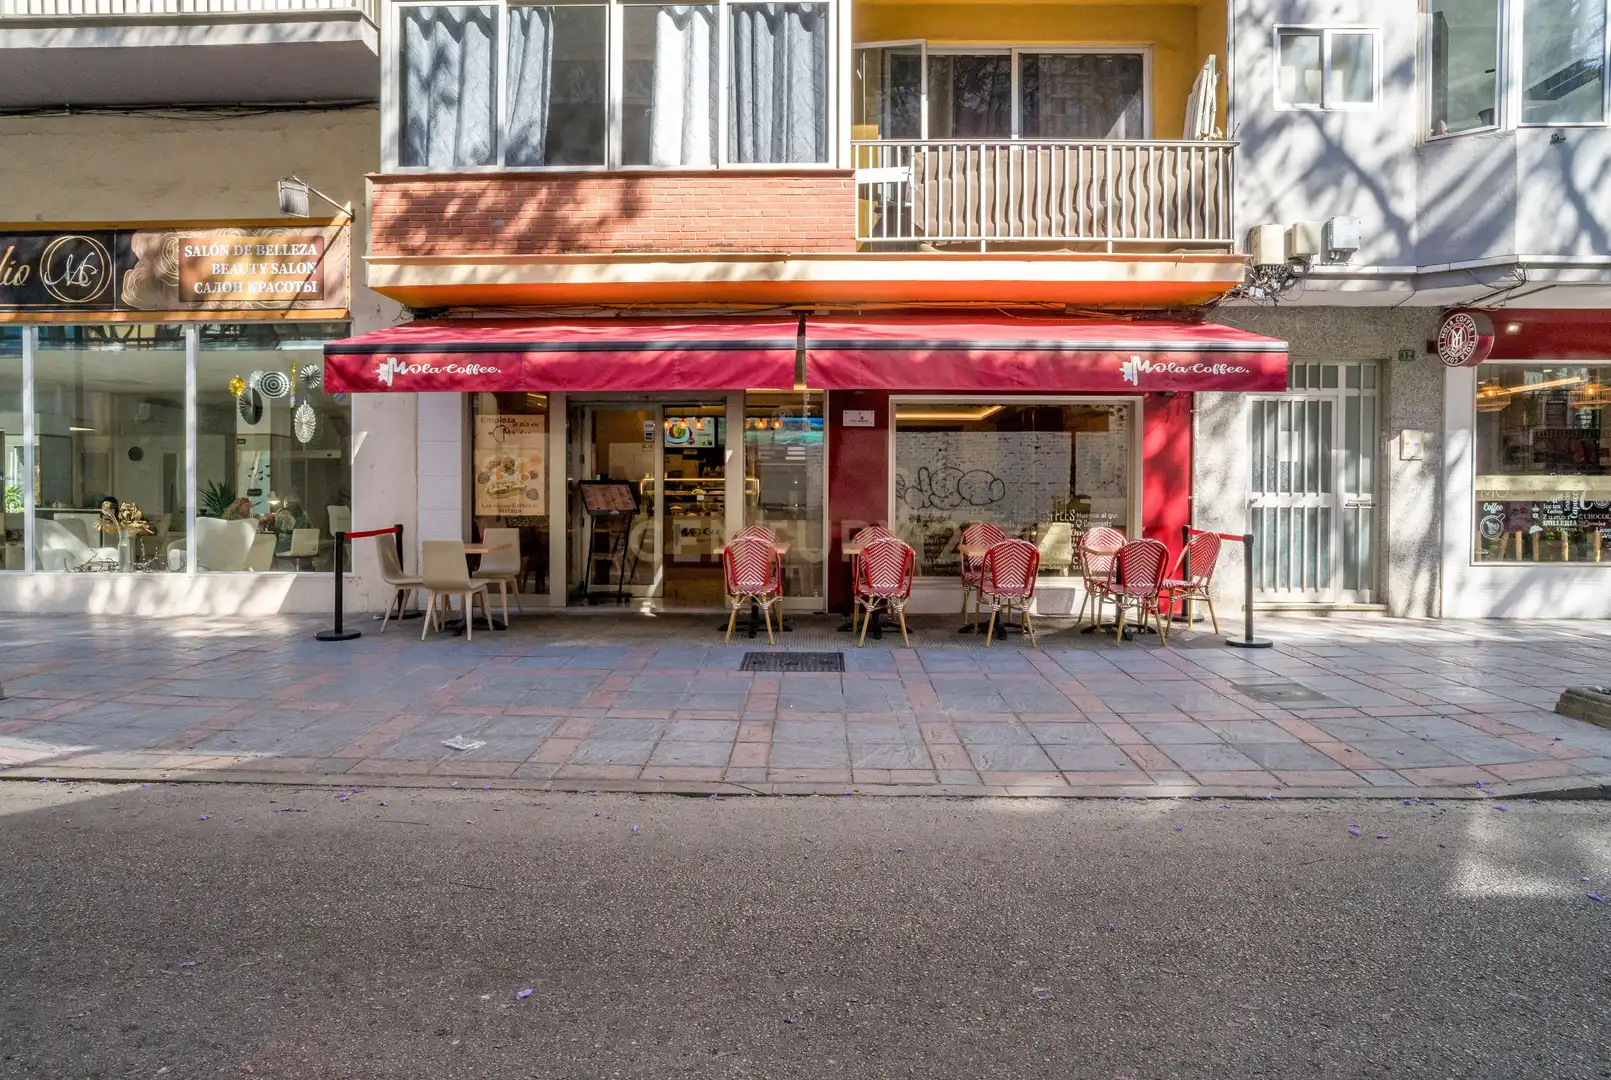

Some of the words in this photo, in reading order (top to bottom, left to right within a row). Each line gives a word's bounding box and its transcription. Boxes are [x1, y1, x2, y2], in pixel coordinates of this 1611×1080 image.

[184, 243, 229, 256] SALÓN
[234, 245, 253, 256] DE
[256, 244, 318, 256] BELLEZA
[212, 263, 267, 275] BEAUTY
[271, 262, 317, 275] SALON
[194, 281, 244, 293] САЛОН
[248, 281, 318, 293] КРАСОТЫ
[1441, 320, 1454, 339] MOLA
[1455, 316, 1475, 332] COFFEE
[1403, 351, 1413, 360] 12
[1440, 346, 1459, 364] COFFEE
[1460, 340, 1474, 360] MOLA
[1483, 502, 1503, 513] Coffee
